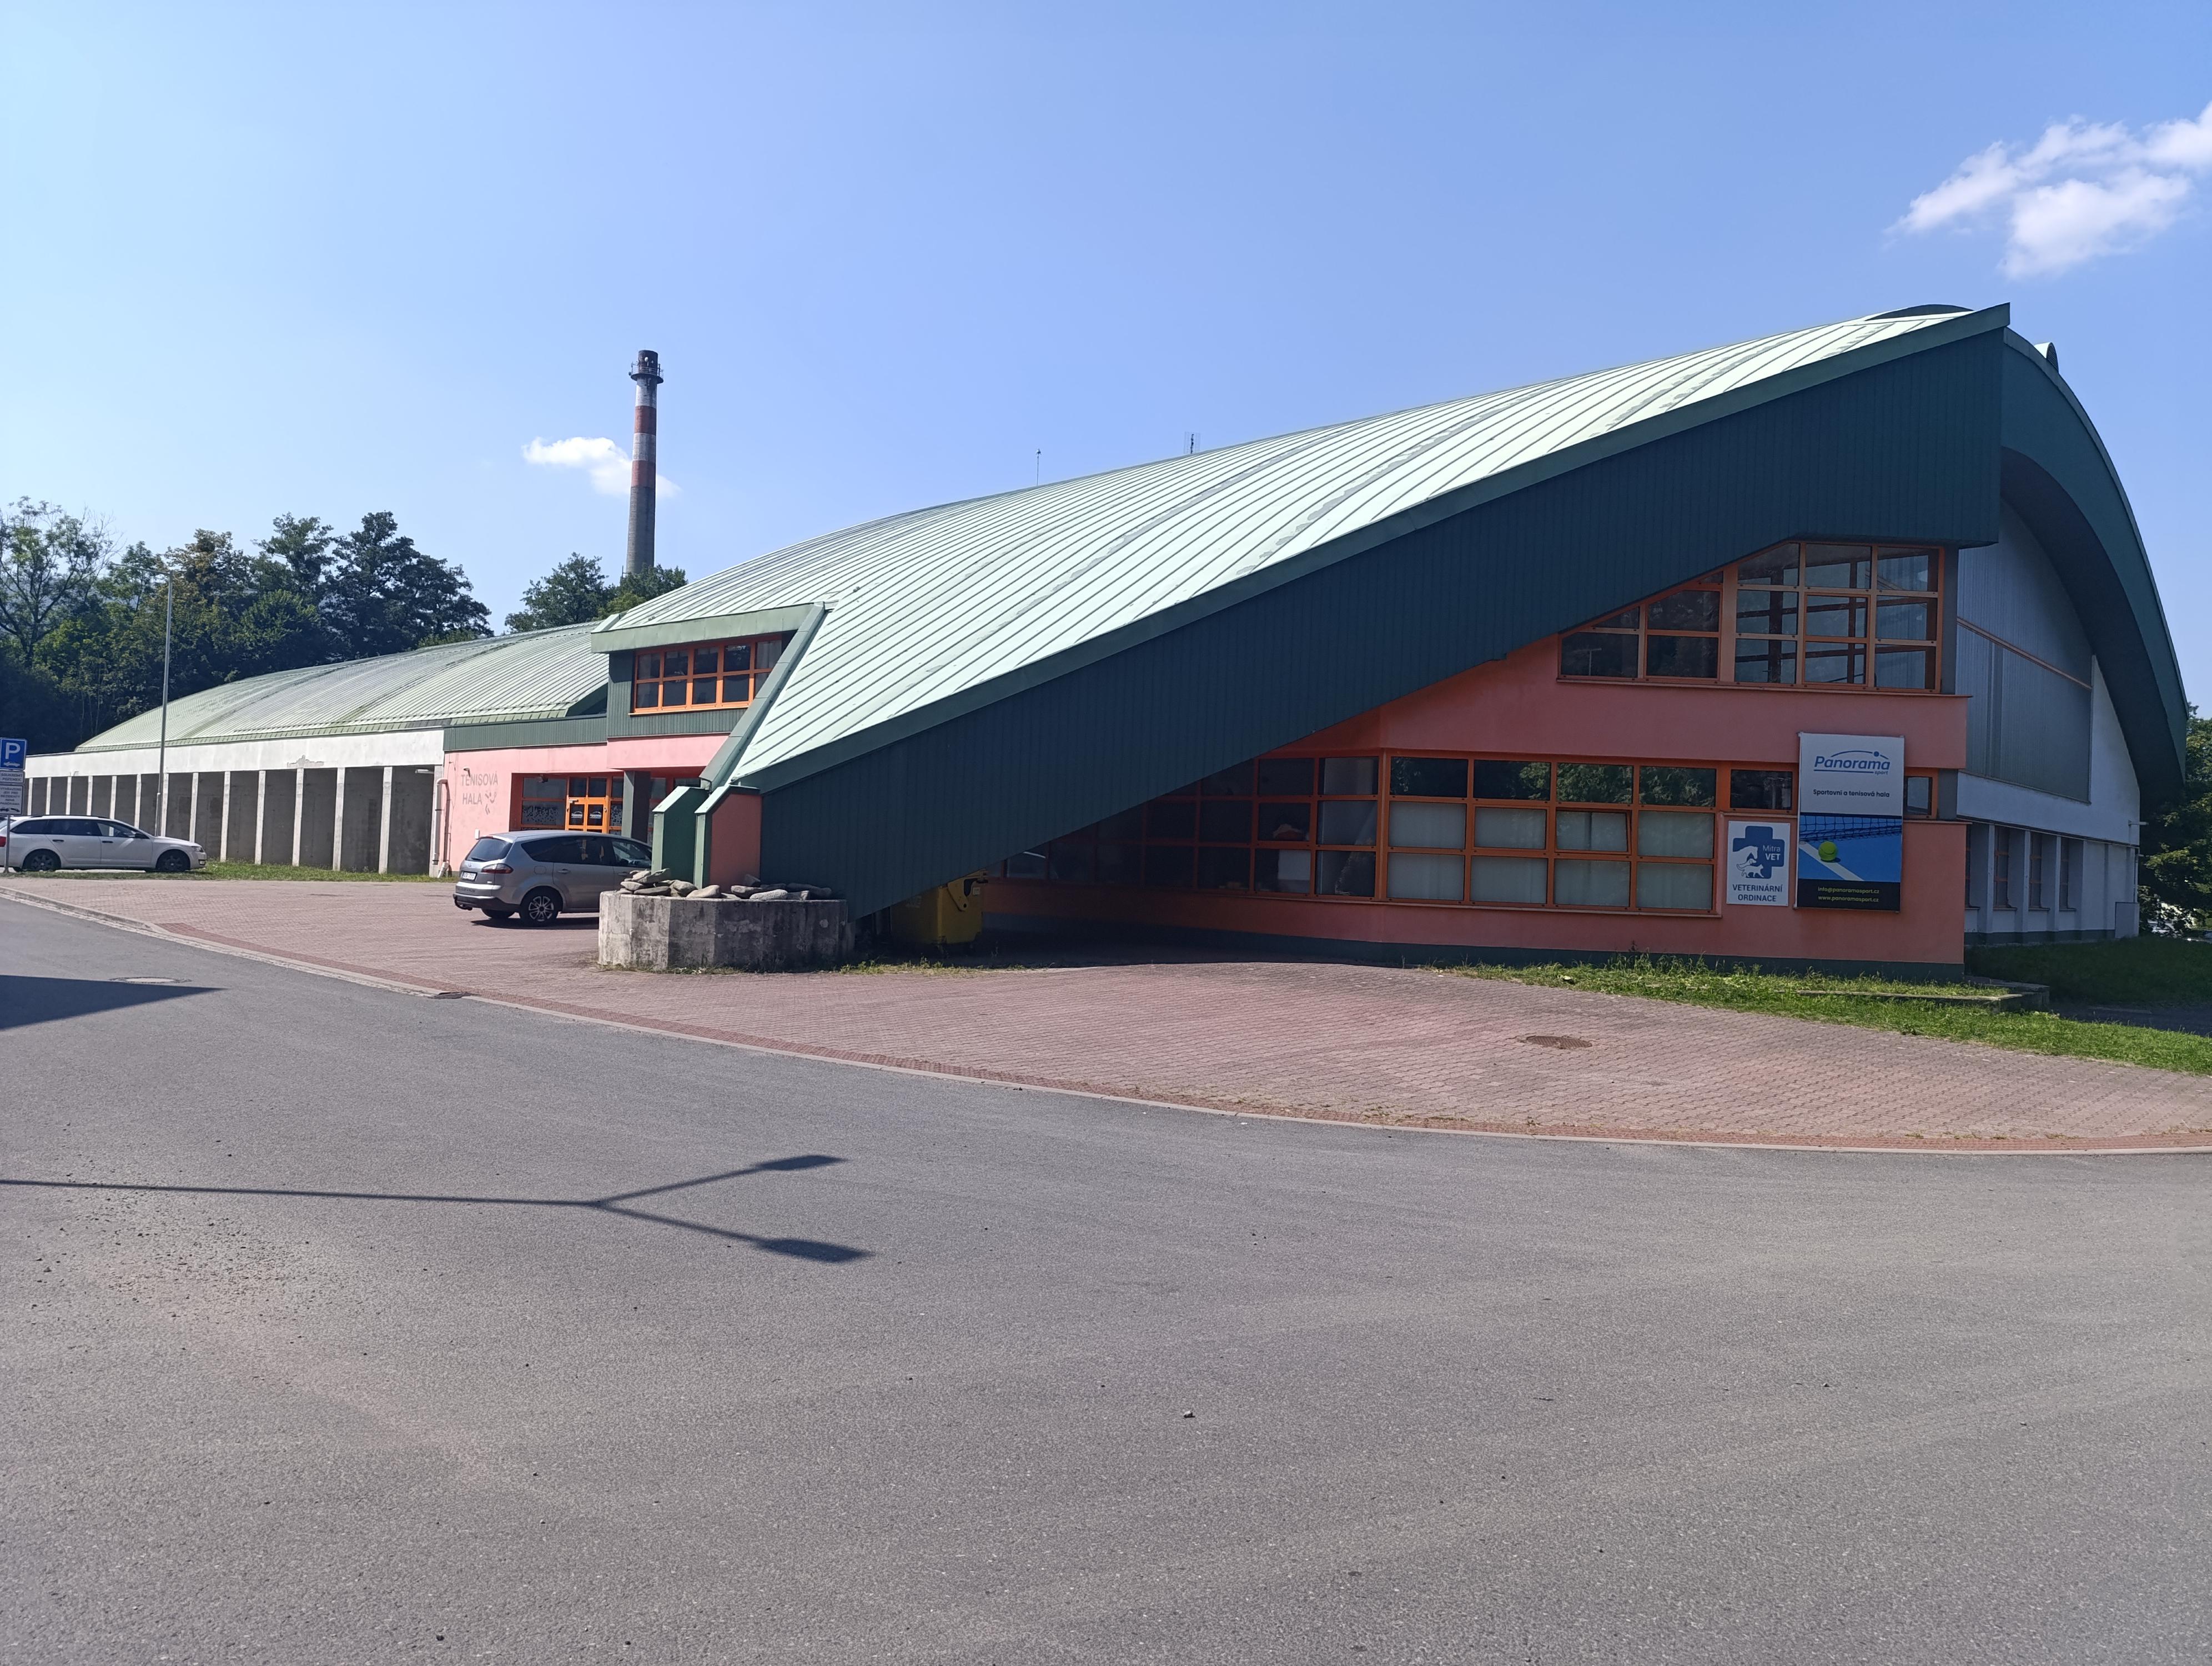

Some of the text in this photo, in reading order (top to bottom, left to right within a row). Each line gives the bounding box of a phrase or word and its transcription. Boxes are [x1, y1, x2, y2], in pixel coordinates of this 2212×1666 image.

[6, 742, 21, 759] P
[1814, 756, 1890, 770] Panorama
[461, 771, 498, 786] TENISOVÁ
[462, 792, 482, 805] HALA
[1732, 884, 1783, 892] VETERINÁRNÍ
